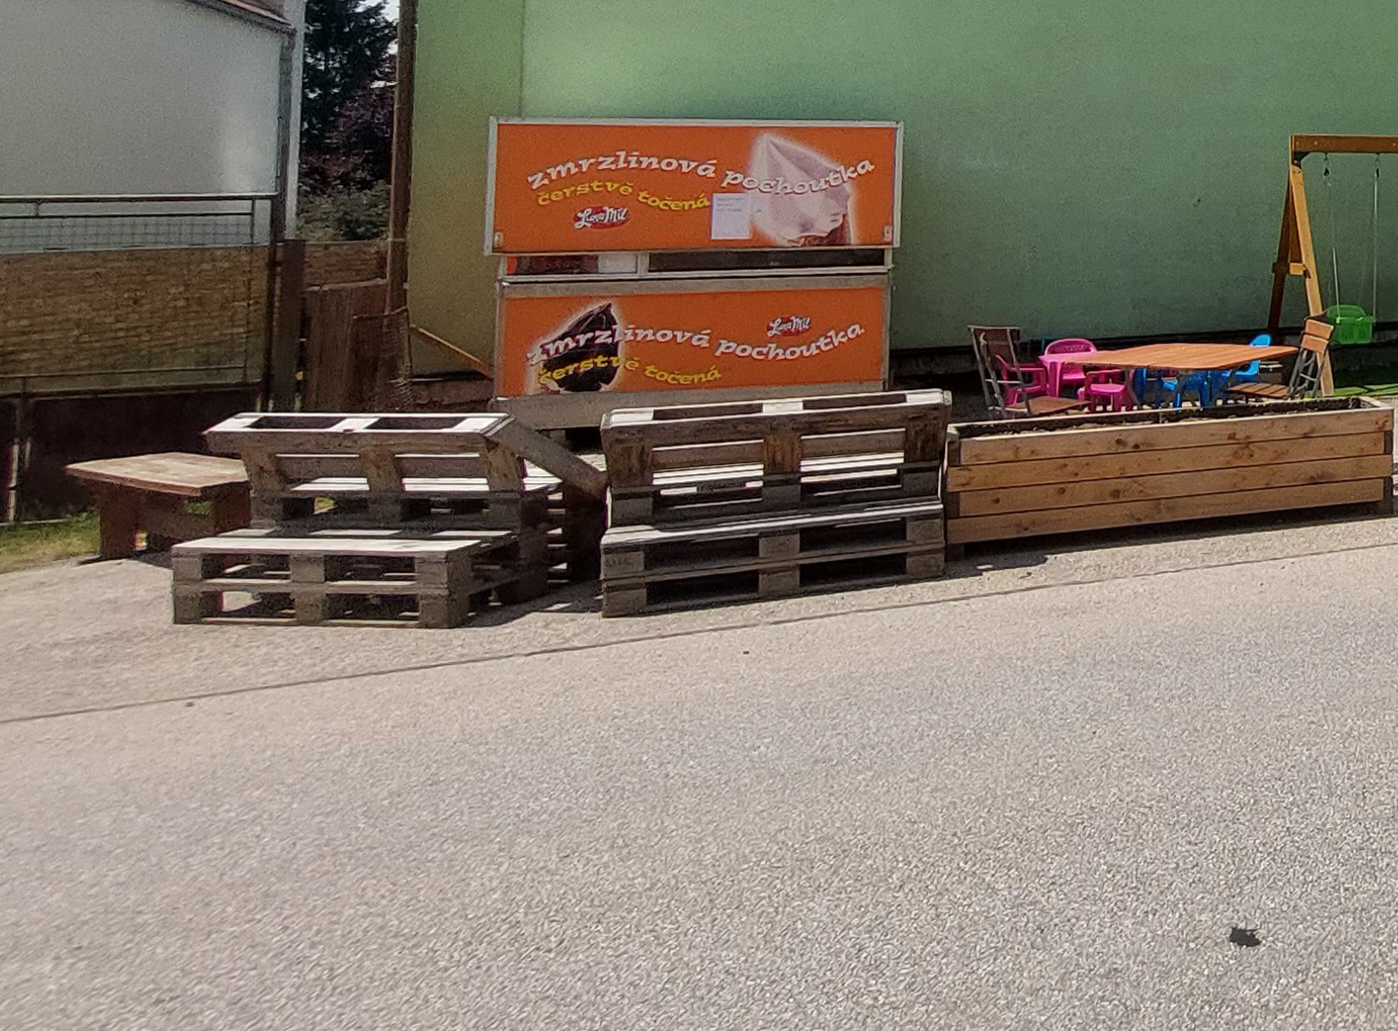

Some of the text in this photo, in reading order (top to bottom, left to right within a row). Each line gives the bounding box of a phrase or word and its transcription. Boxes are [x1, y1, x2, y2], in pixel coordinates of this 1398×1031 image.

[527, 150, 875, 196] zmrzlinová pochoutka
[537, 178, 634, 207] čerstvě
[637, 188, 710, 211] točená
[526, 323, 864, 367] zmrzlinová pochoutka
[537, 355, 721, 386] čerstvě točená
